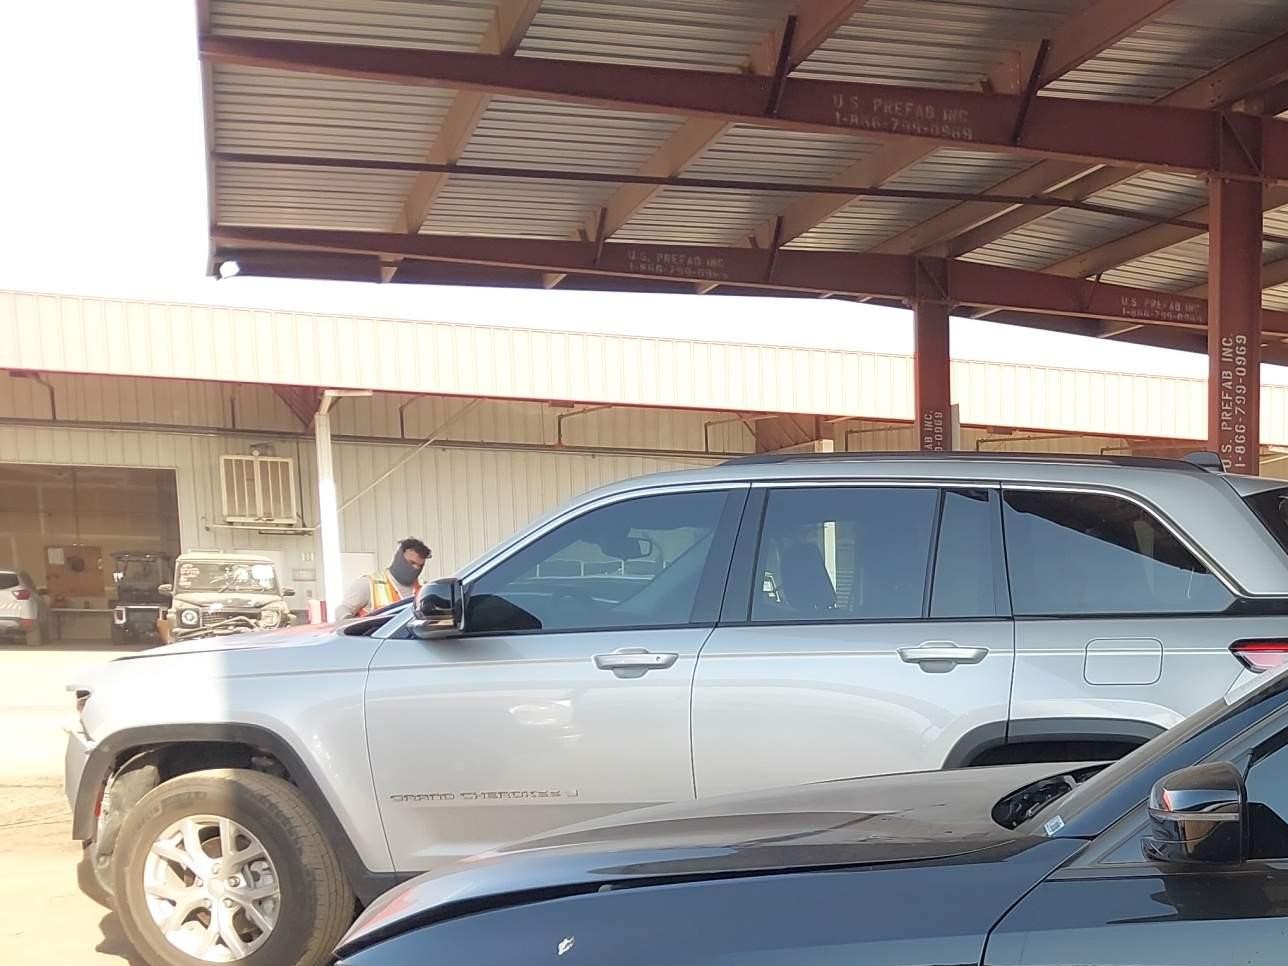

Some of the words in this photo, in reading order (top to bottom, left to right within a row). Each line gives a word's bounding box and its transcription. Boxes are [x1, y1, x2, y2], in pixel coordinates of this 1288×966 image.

[873, 97, 935, 120] PREFAB
[656, 252, 702, 267] PREFAB
[1221, 370, 1233, 431] PREFAB
[1235, 335, 1247, 467] 1-866-799-0969
[1221, 439, 1232, 469] U.S.
[460, 790, 561, 800] CHEROKEE
